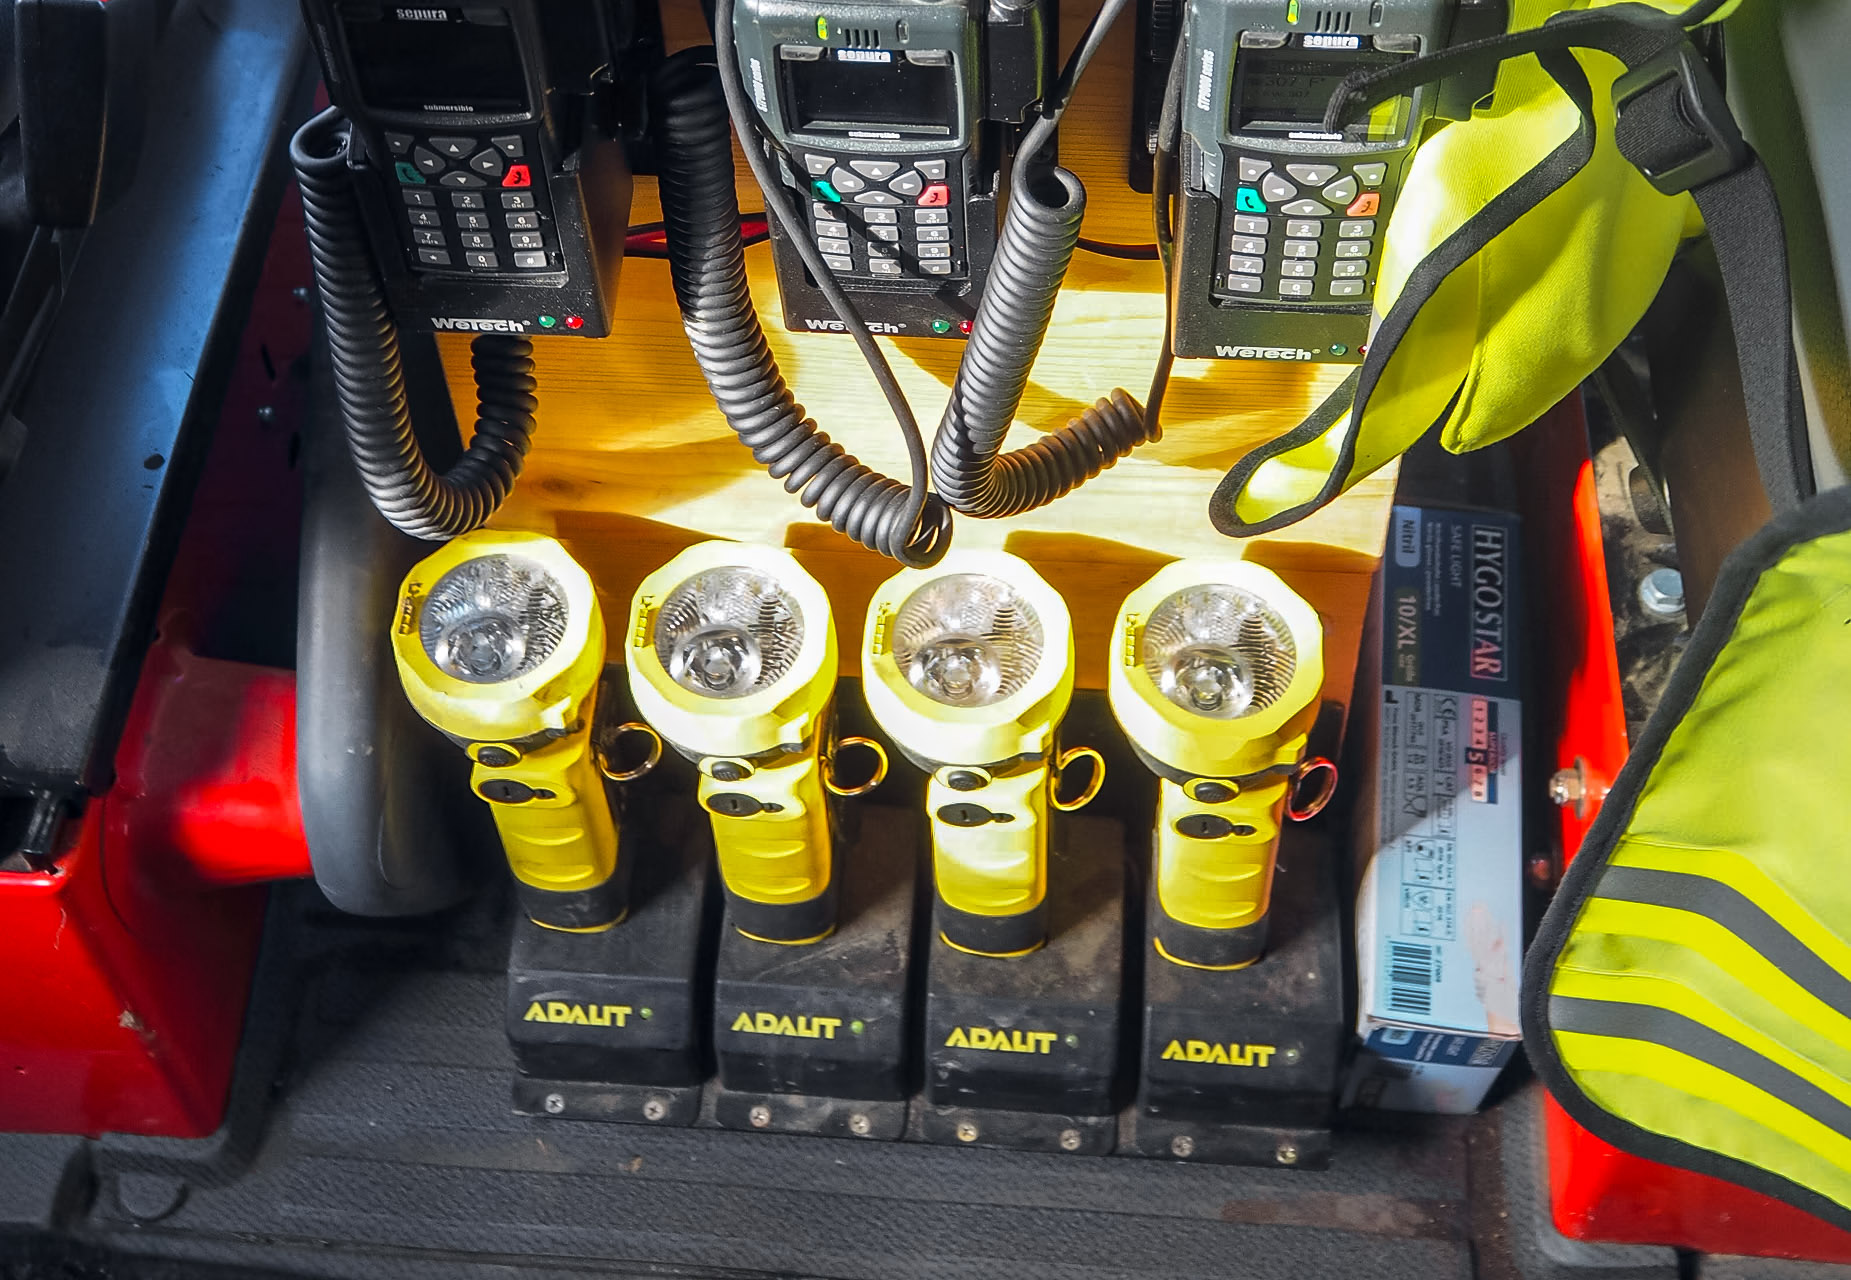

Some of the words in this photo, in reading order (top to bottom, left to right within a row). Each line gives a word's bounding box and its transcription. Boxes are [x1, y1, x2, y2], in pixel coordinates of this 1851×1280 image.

[396, 6, 448, 21] sepura
[1402, 519, 1416, 554] Nitril
[1450, 523, 1463, 552] SAFE
[1450, 553, 1463, 589] LIGHT
[1474, 529, 1503, 674] HYGOSTAR
[1397, 594, 1417, 649] 10/XL
[1468, 751, 1484, 761] 5
[524, 1002, 633, 1027] ADALIT
[731, 1012, 843, 1039] ADALIT
[945, 1027, 1058, 1054] ADALIT
[1161, 1040, 1276, 1068] ADALIT
